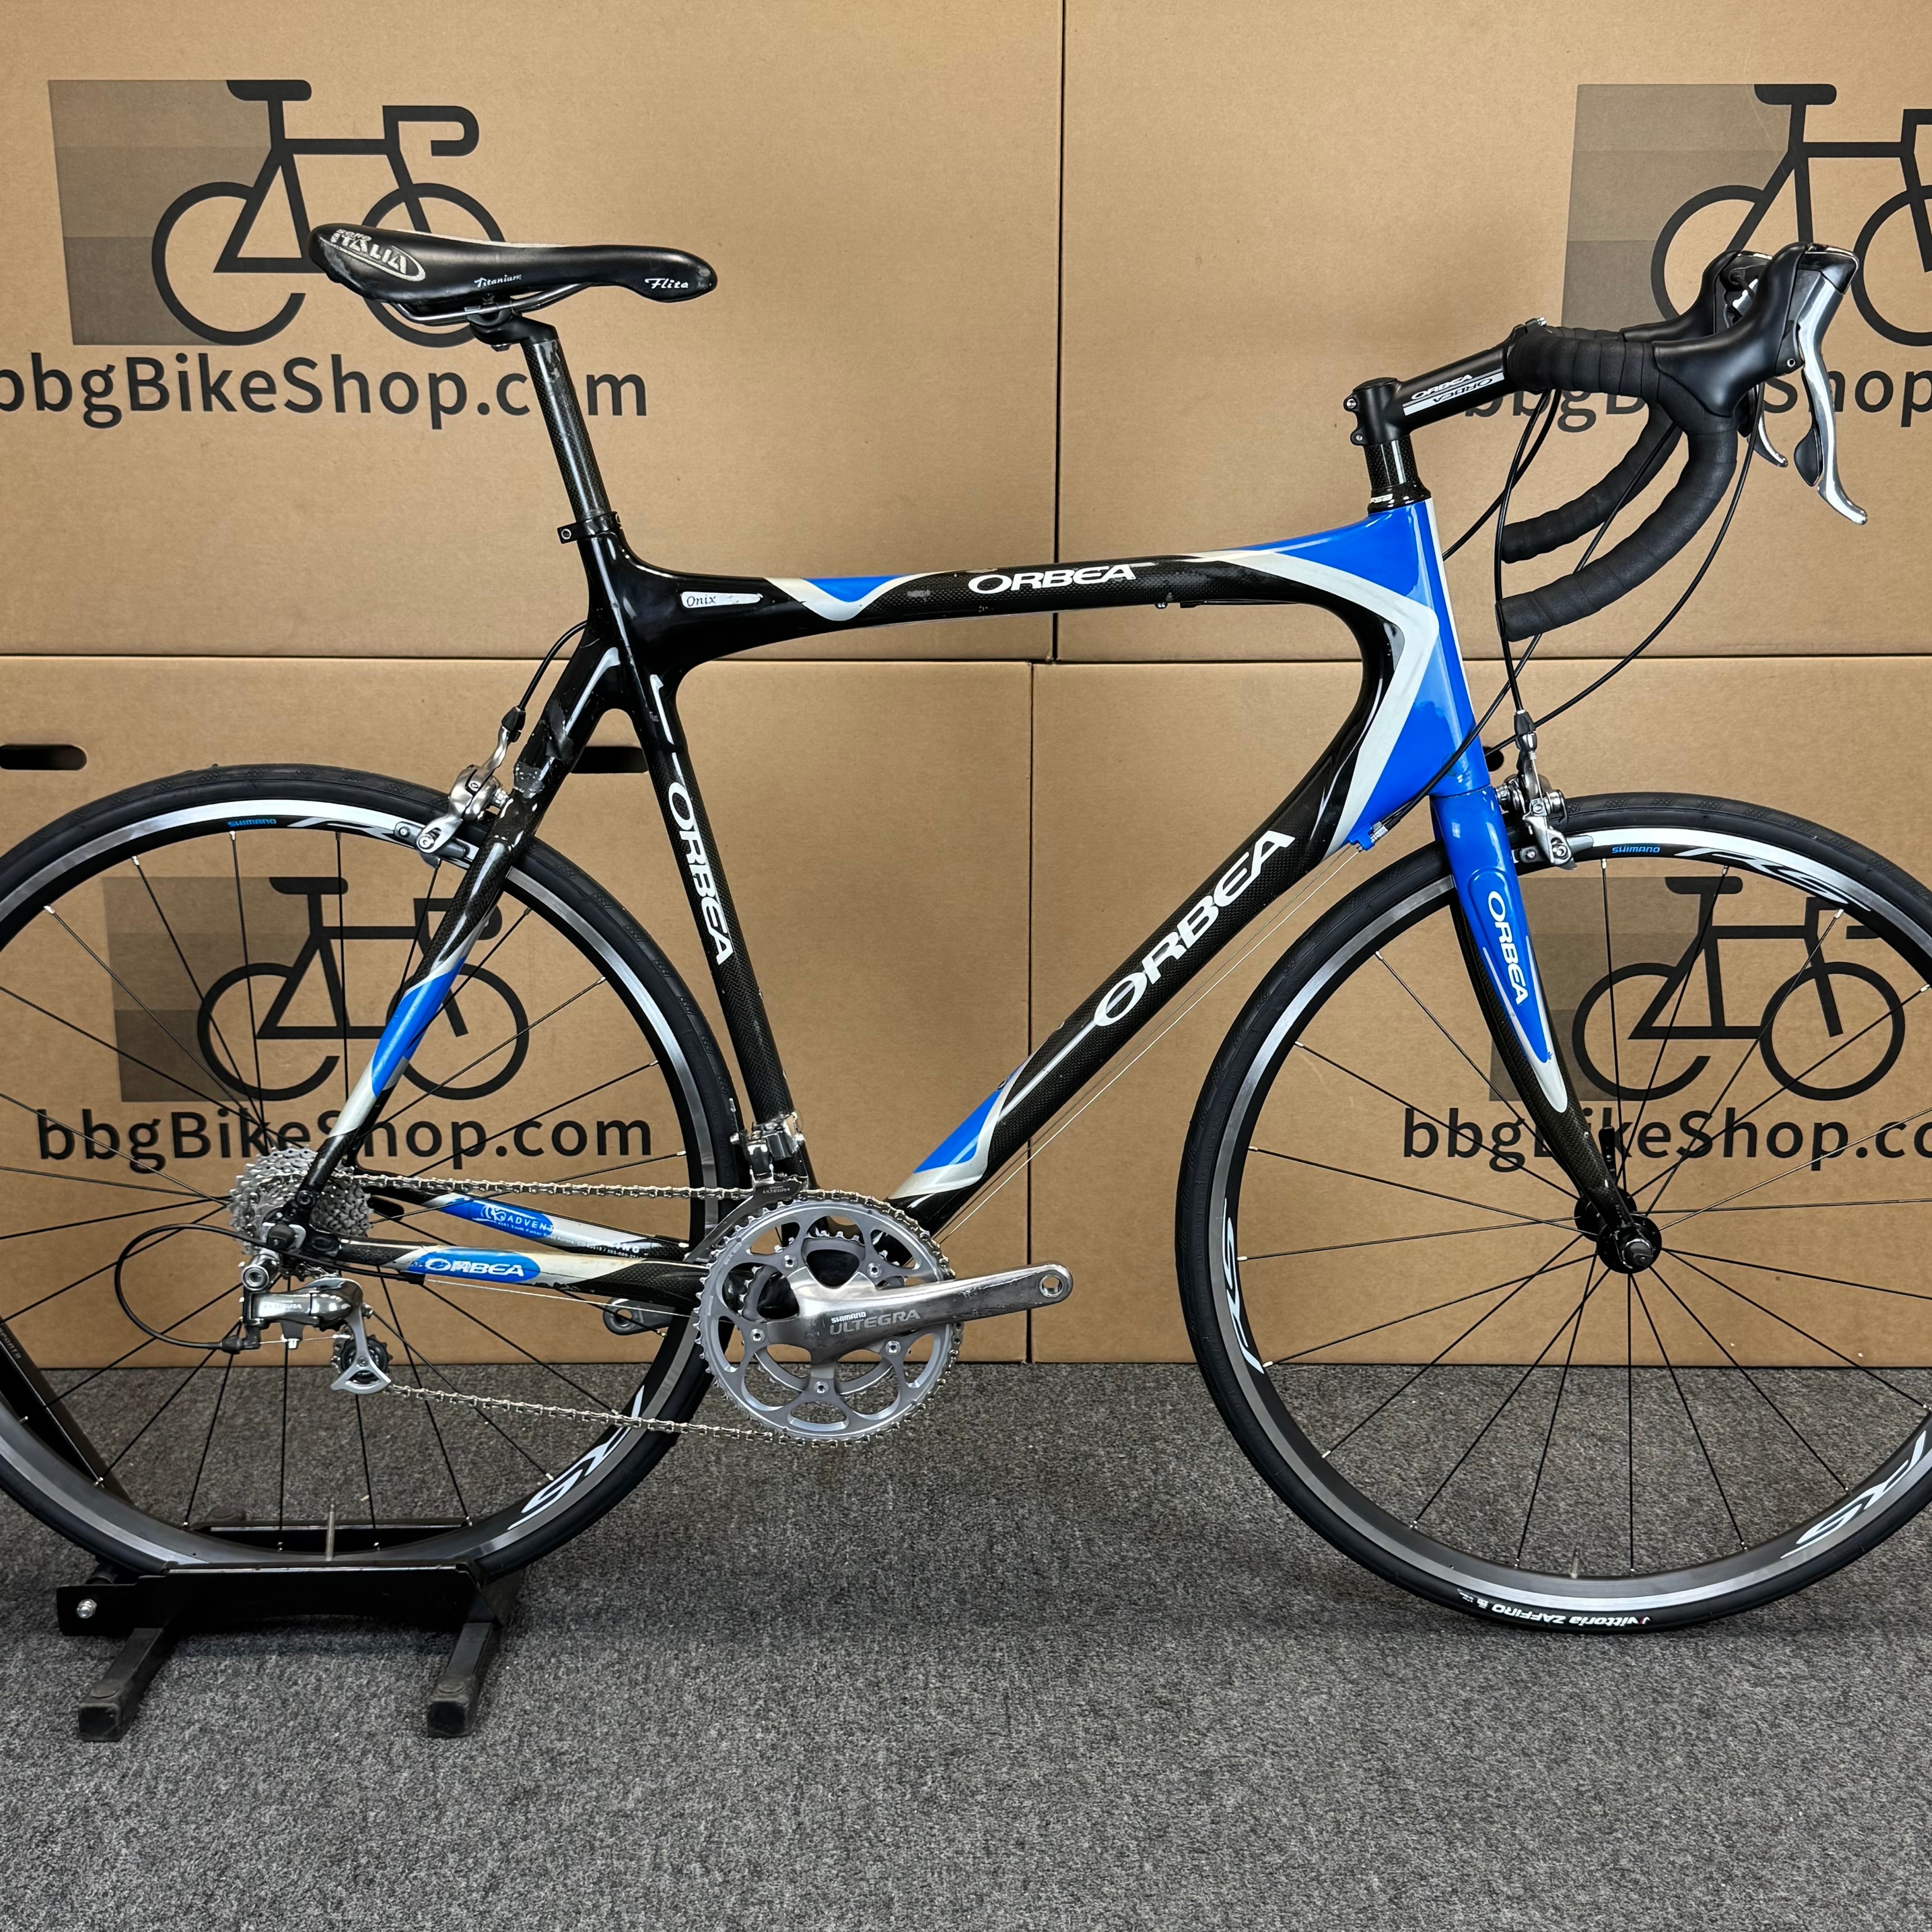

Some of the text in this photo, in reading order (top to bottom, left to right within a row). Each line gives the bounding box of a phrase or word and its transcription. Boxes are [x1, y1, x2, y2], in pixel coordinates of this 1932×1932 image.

[330, 232, 407, 274] ITALIA
[968, 564, 1136, 594] ORBEA
[686, 595, 716, 607] Onix
[668, 782, 733, 965] ORBEA
[1094, 830, 1295, 1027] ORBEA
[1488, 891, 1529, 1005] ORBEA
[425, 1258, 524, 1277] ORBEA
[830, 1310, 920, 1335] ULTEGRA
[1491, 1604, 1566, 1624] ZAFFIRO
